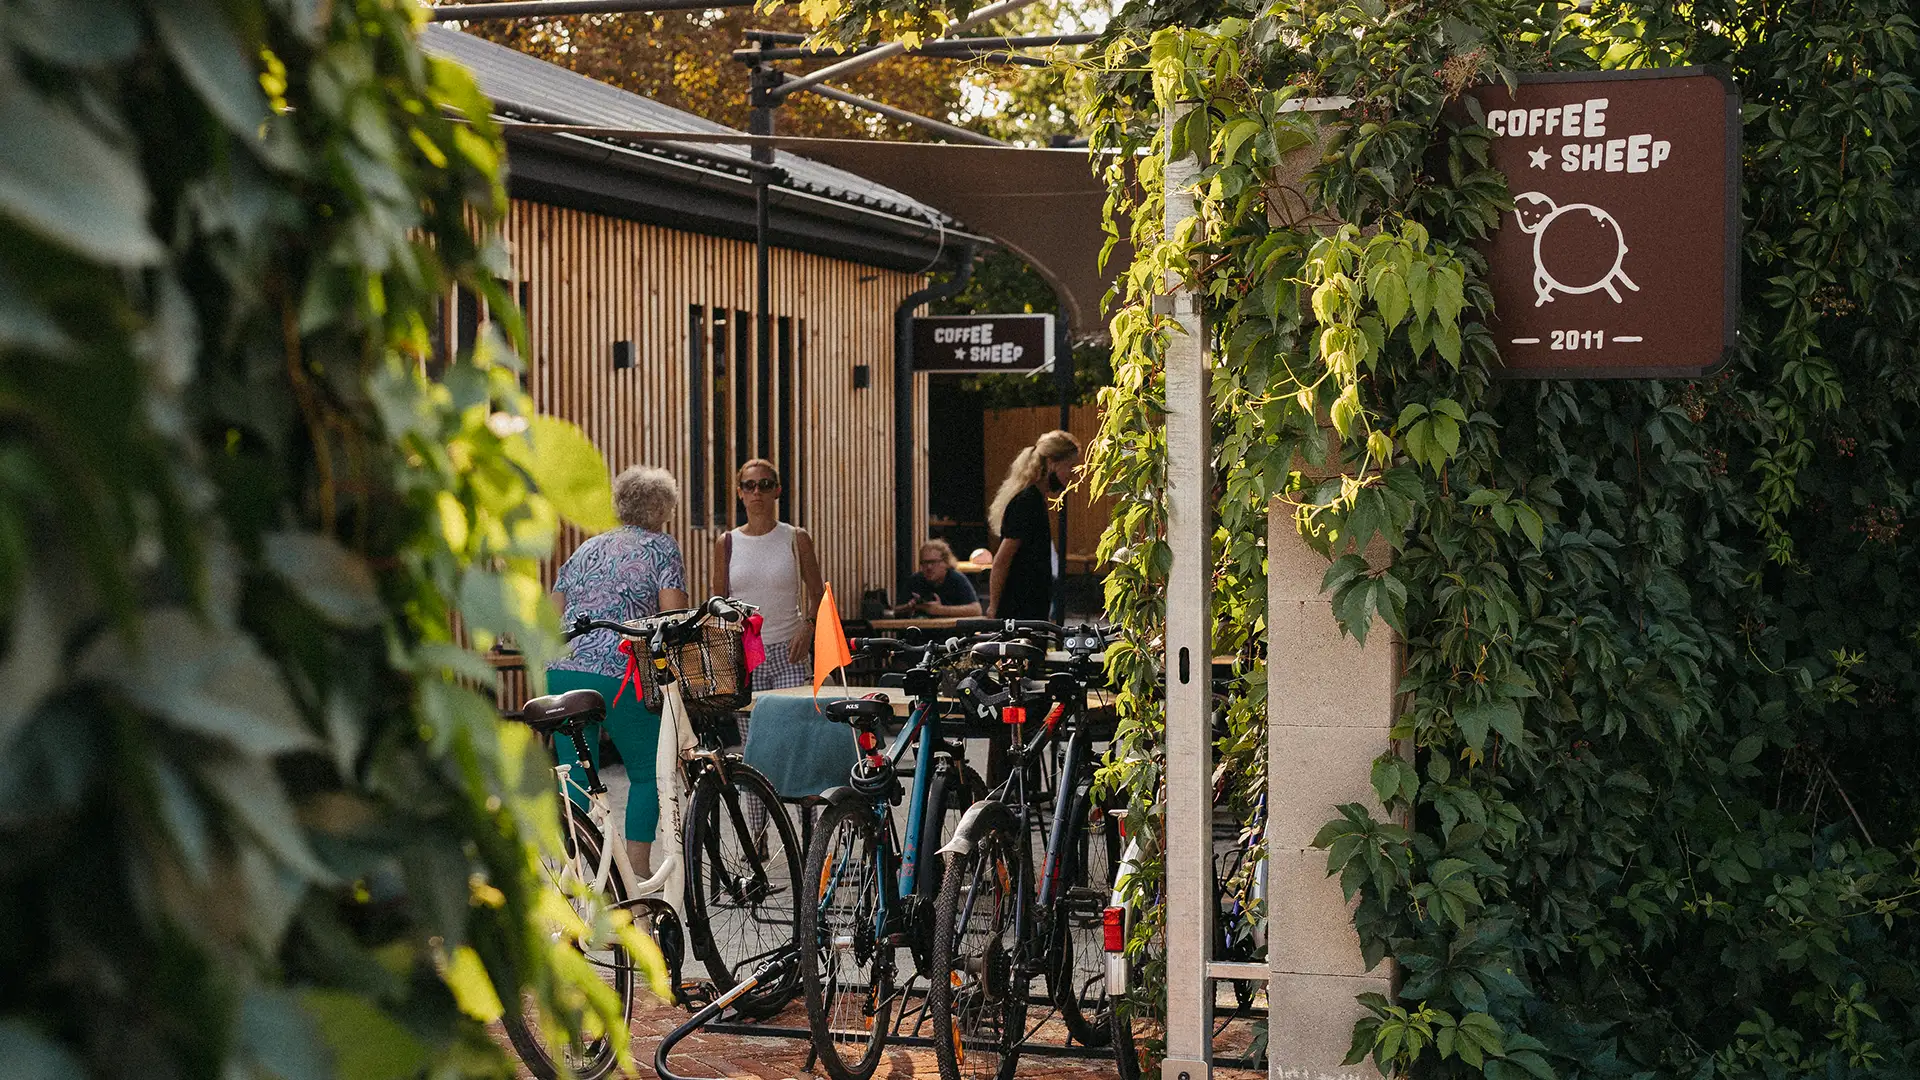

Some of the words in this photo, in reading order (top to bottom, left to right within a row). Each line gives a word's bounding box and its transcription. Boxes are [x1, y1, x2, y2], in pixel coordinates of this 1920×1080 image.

[1487, 98, 1609, 137] COFFEE
[1561, 134, 1671, 173] SHEEP
[934, 323, 994, 345] COFFEE
[1550, 330, 1604, 350] 2011
[969, 342, 1024, 363] SHEEP
